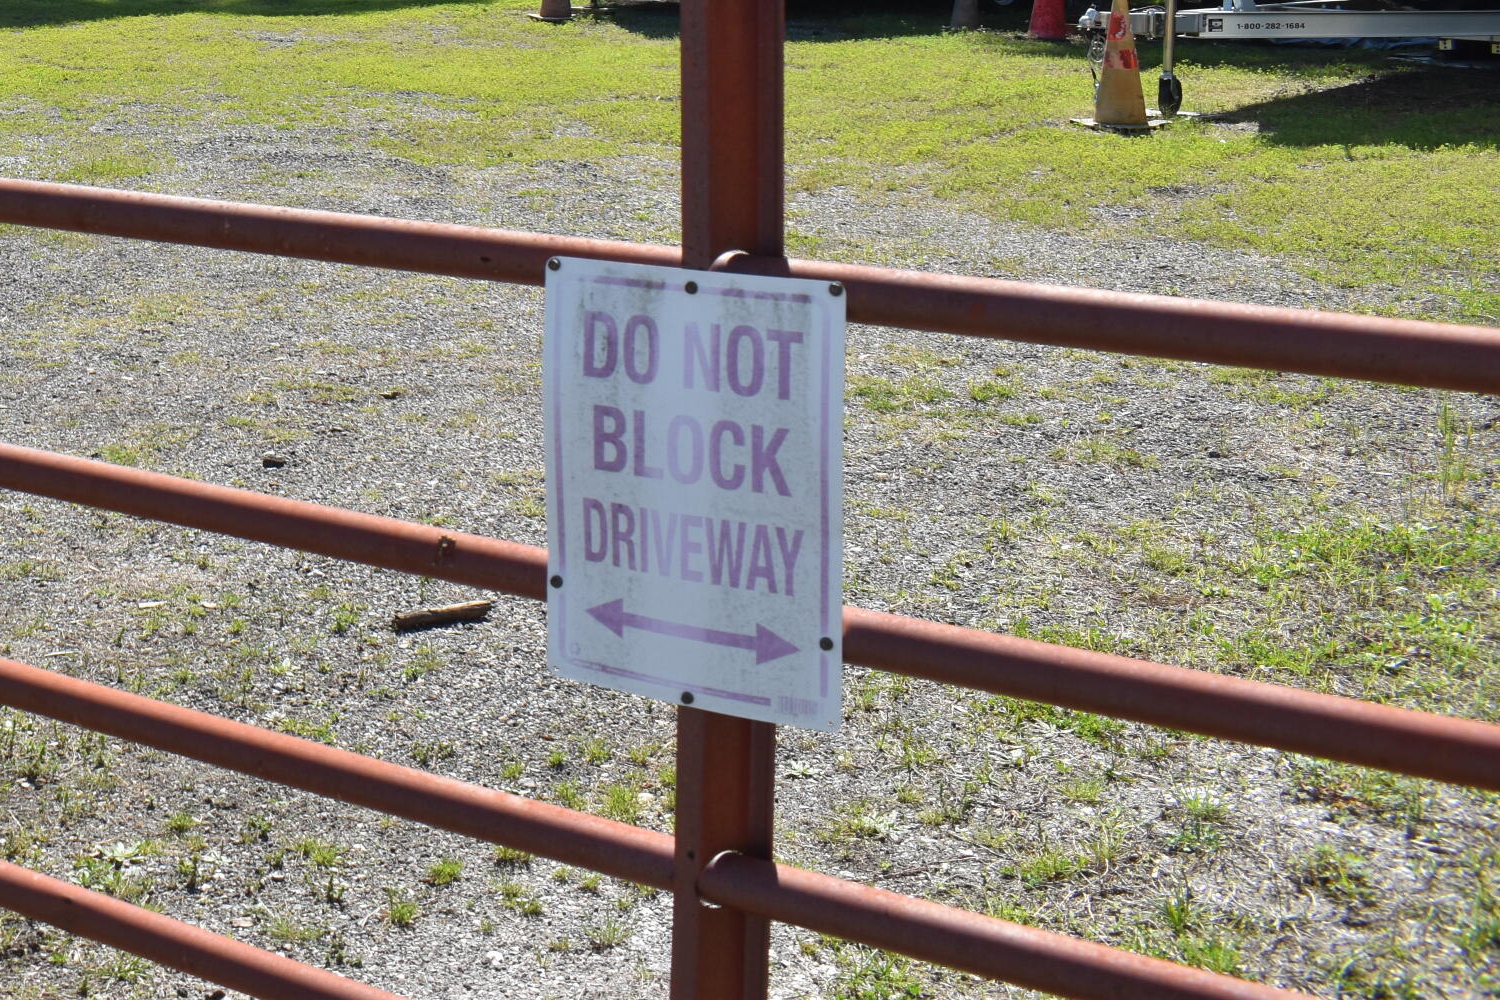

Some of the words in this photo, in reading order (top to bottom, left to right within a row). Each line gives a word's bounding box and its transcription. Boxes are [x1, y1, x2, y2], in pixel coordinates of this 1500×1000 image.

[1236, 22, 1306, 30] 1-800-282-1684
[583, 311, 661, 385] DO
[683, 321, 804, 401] NOT
[593, 404, 793, 498] BLOCK
[583, 496, 805, 598] DRIVEWAY
